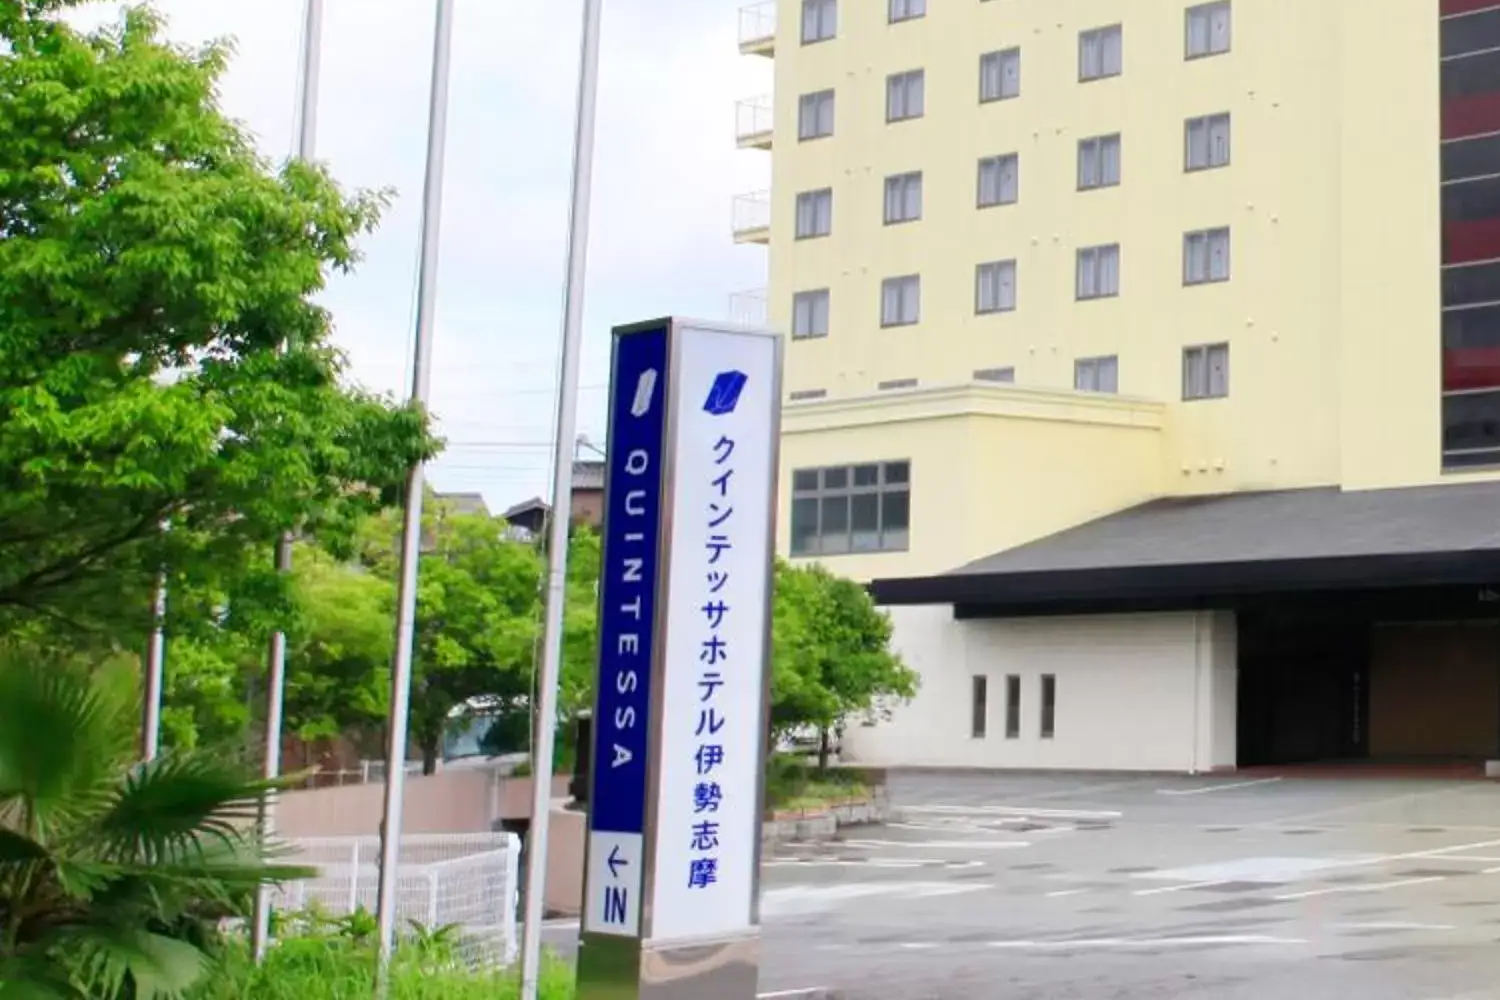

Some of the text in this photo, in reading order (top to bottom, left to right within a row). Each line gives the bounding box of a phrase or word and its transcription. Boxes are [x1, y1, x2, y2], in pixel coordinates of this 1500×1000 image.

[611, 449, 648, 768] QUINTESSA
[688, 435, 735, 889] クインテッサホテル伊勢志摩
[604, 886, 627, 924] IN
